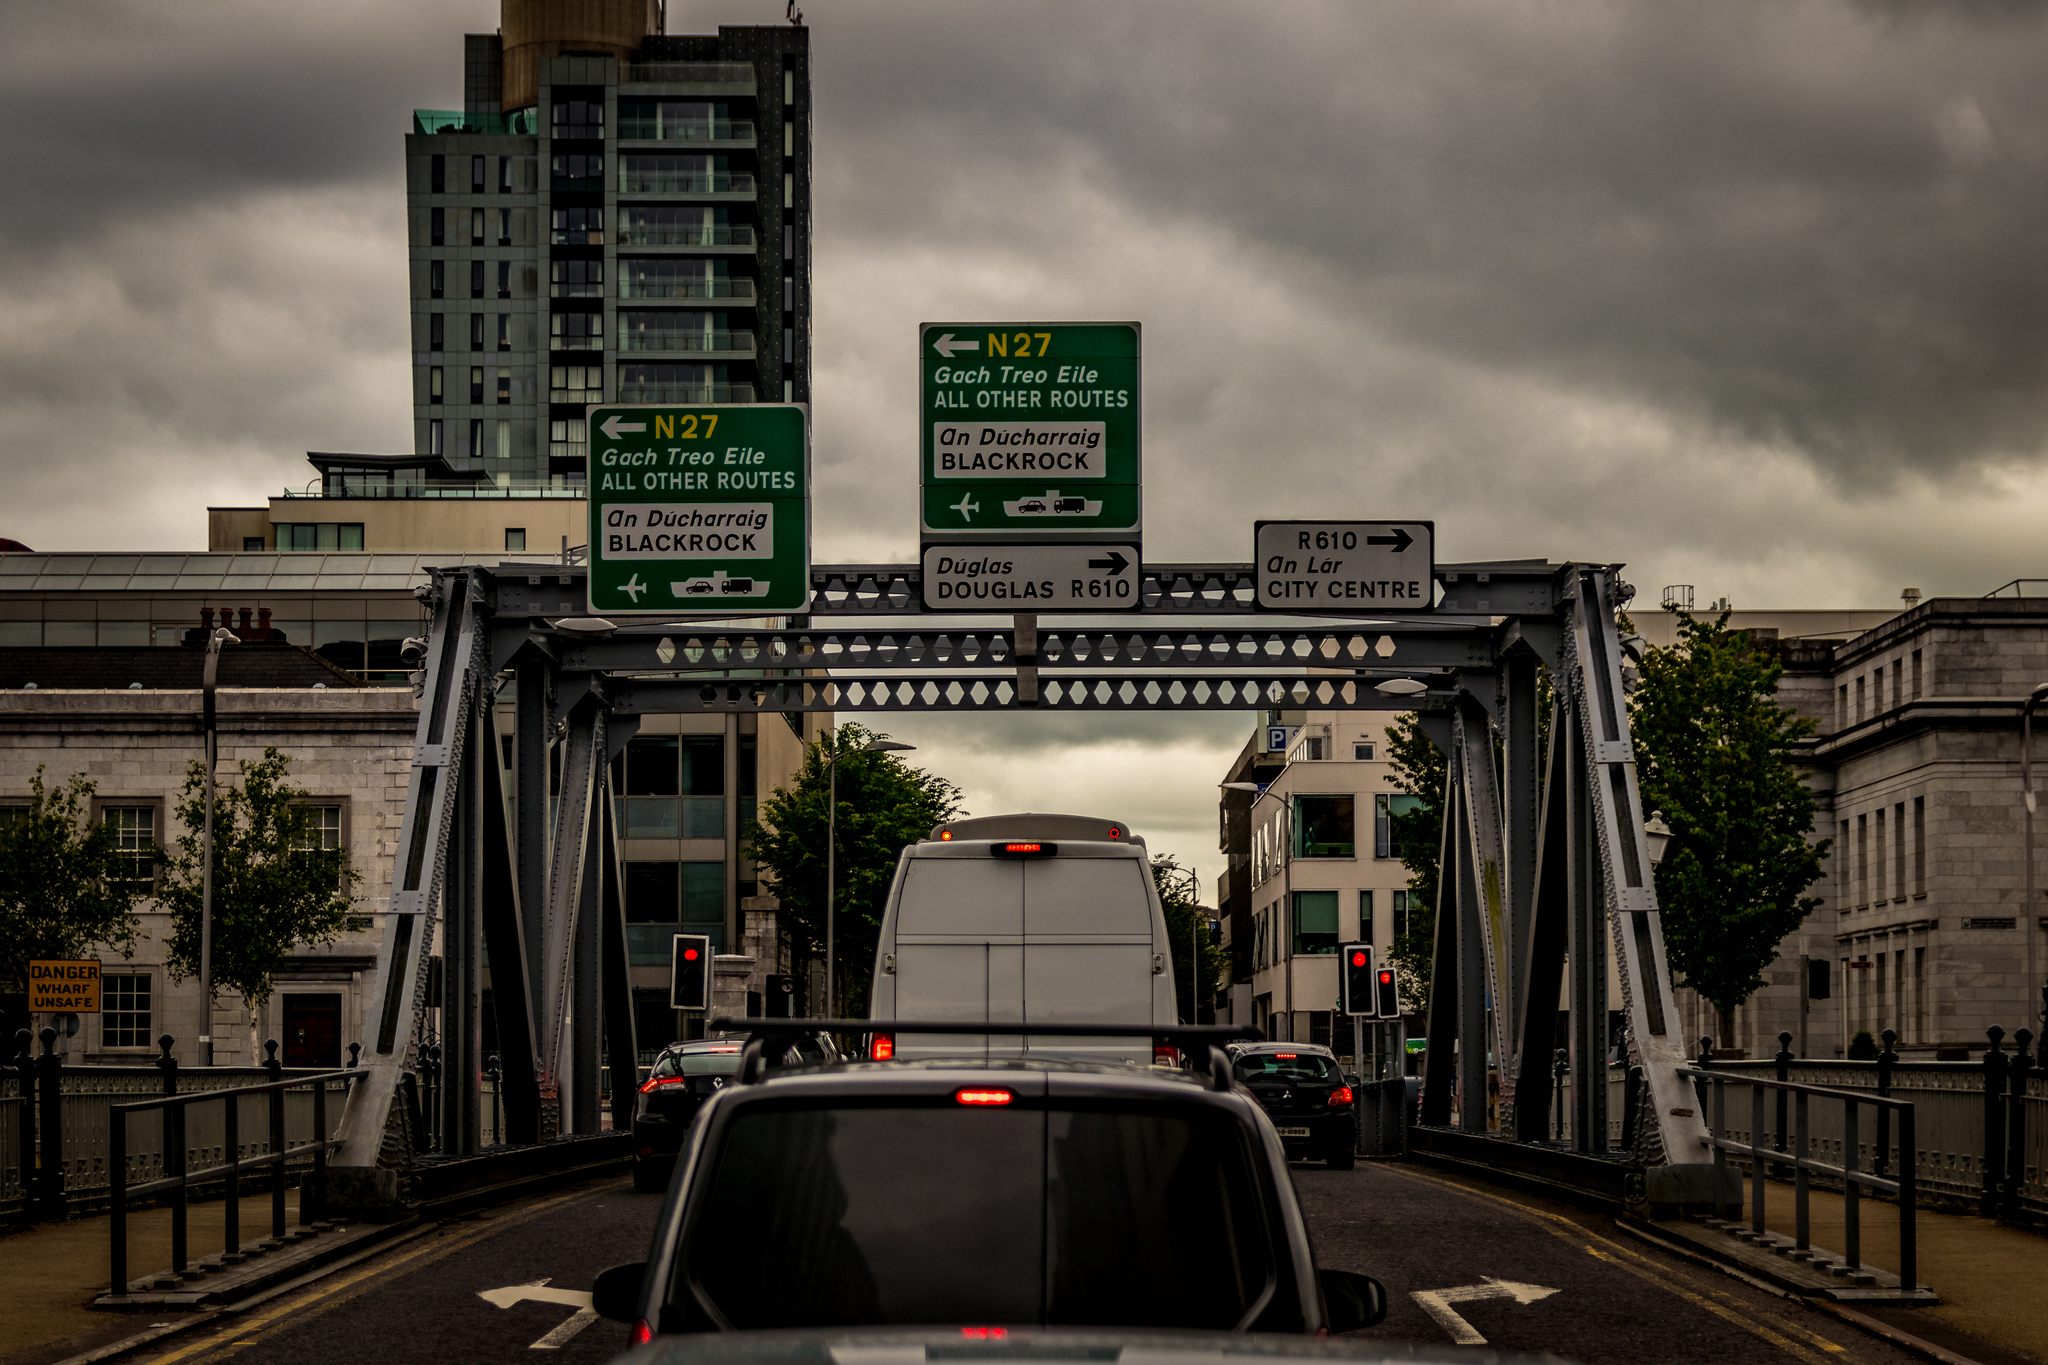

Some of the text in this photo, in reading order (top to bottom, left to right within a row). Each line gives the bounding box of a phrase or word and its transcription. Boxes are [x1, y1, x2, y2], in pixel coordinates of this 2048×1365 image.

[989, 333, 1051, 357] N27
[934, 365, 1099, 384] Gach Treo Eile
[934, 389, 1129, 408] ALL OTHER ROUTES
[655, 414, 719, 439] N27
[940, 428, 1101, 449] An Dúcharraig
[601, 447, 766, 466] Gach Treo Eile
[941, 452, 1090, 471] BLACKROCK
[601, 471, 796, 490] ALL OTHER ROUTES
[607, 510, 768, 530] An Dúcharraig
[609, 533, 757, 552] BLACKROCK
[1298, 531, 1358, 550] R610
[936, 557, 1014, 578] Dúglas
[1266, 556, 1344, 574] An Lár
[938, 579, 1130, 599] DOUGLAS R610
[1267, 580, 1421, 598] CITY CENTRE
[1271, 730, 1285, 748] P
[31, 966, 99, 979] DANGER
[36, 984, 91, 994] WHARF
[34, 997, 93, 1008] UNSAFE
